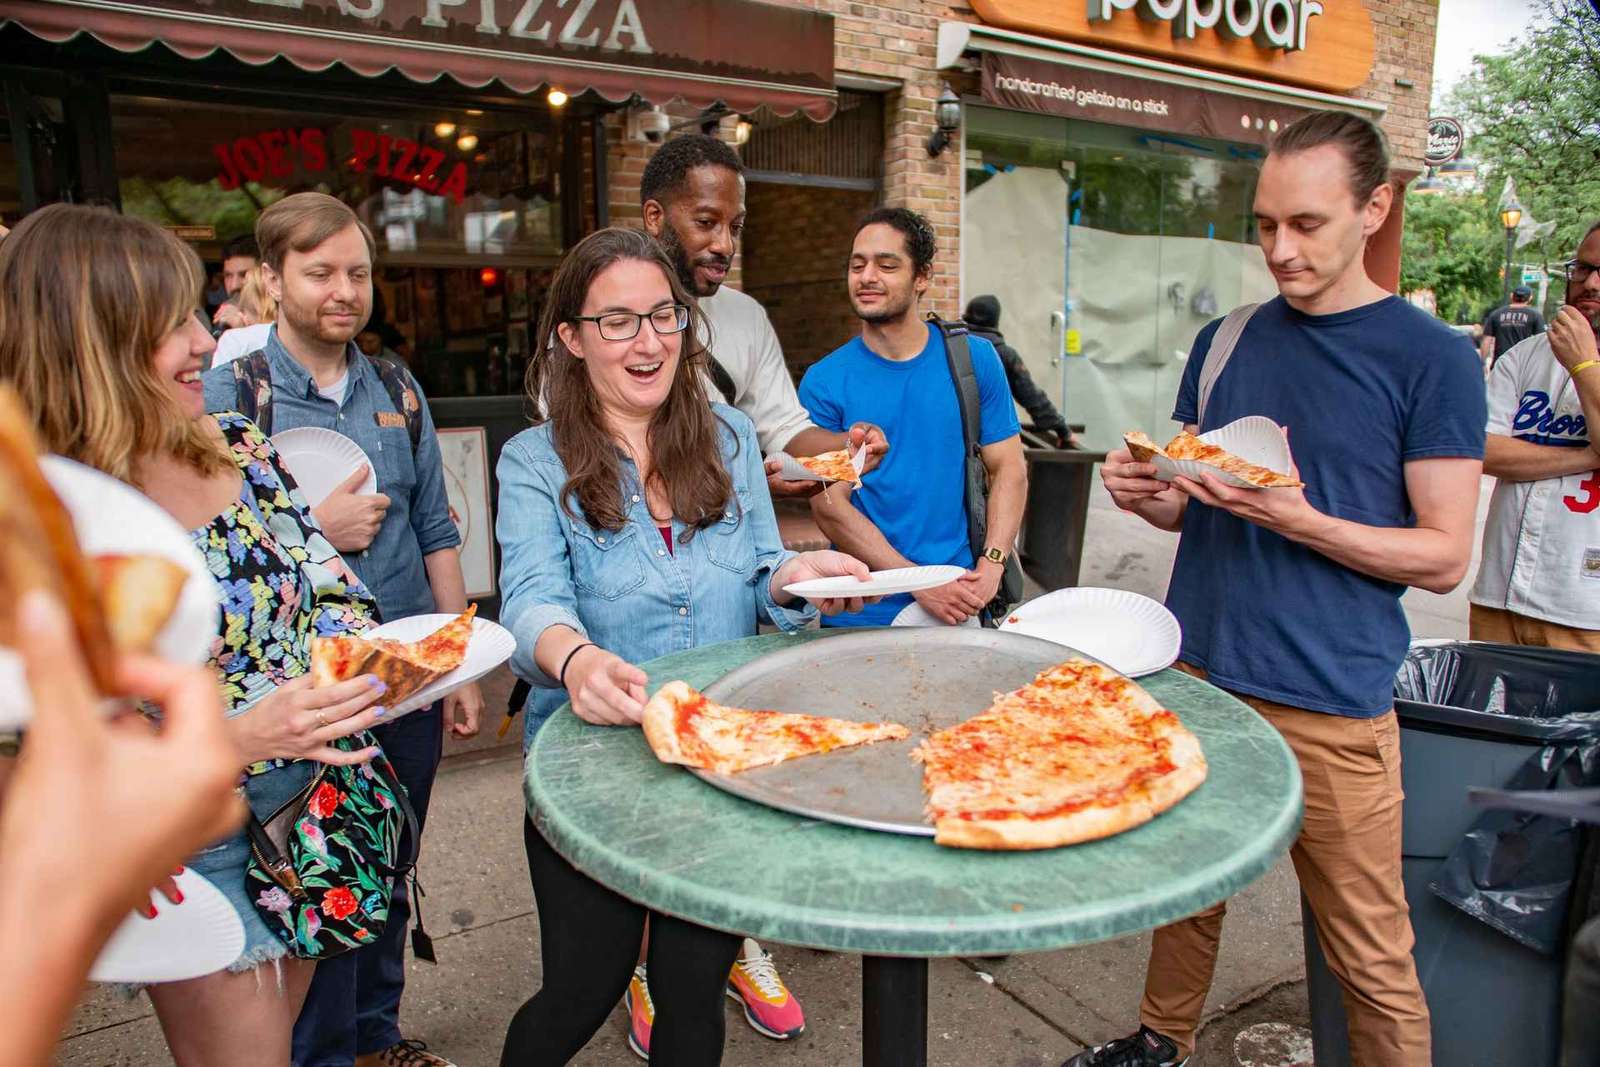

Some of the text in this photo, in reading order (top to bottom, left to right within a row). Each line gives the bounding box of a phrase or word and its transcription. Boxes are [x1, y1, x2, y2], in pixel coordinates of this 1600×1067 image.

[421, 0, 653, 53] PIZZA
[995, 73, 1169, 116] handcrafted gelato on a stick
[213, 127, 468, 205] JOE'S PIZZA
